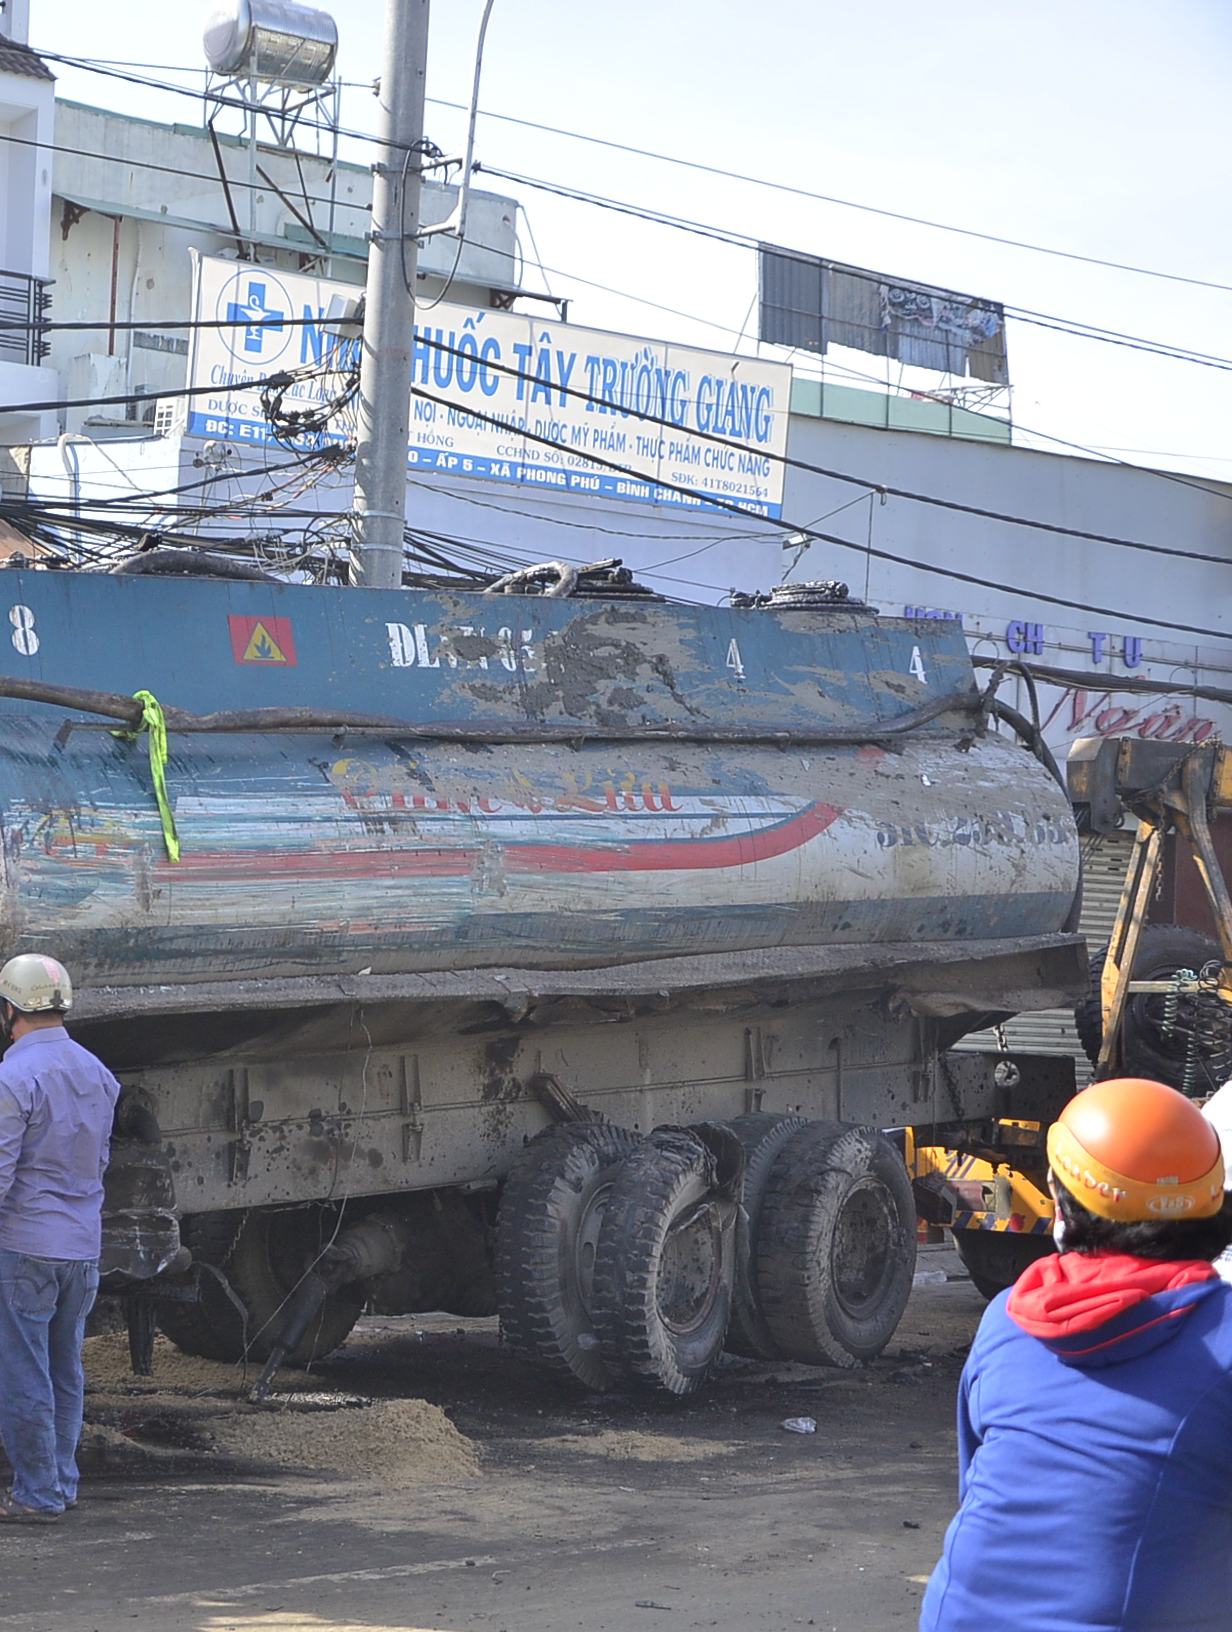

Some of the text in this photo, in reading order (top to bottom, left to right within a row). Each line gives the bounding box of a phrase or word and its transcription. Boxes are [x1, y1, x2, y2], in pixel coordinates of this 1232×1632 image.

[412, 312, 501, 396] HUỐC
[513, 332, 577, 408] TÂY
[584, 346, 690, 427] TRƯỜNG
[463, 459, 473, 471] 5
[490, 461, 511, 477] XÃ
[516, 467, 567, 486] PHONG
[570, 475, 600, 490] PHÚ
[616, 481, 650, 498] BÌNH
[8, 604, 40, 656] 8
[726, 637, 746, 679] 4
[909, 645, 927, 685] 4
